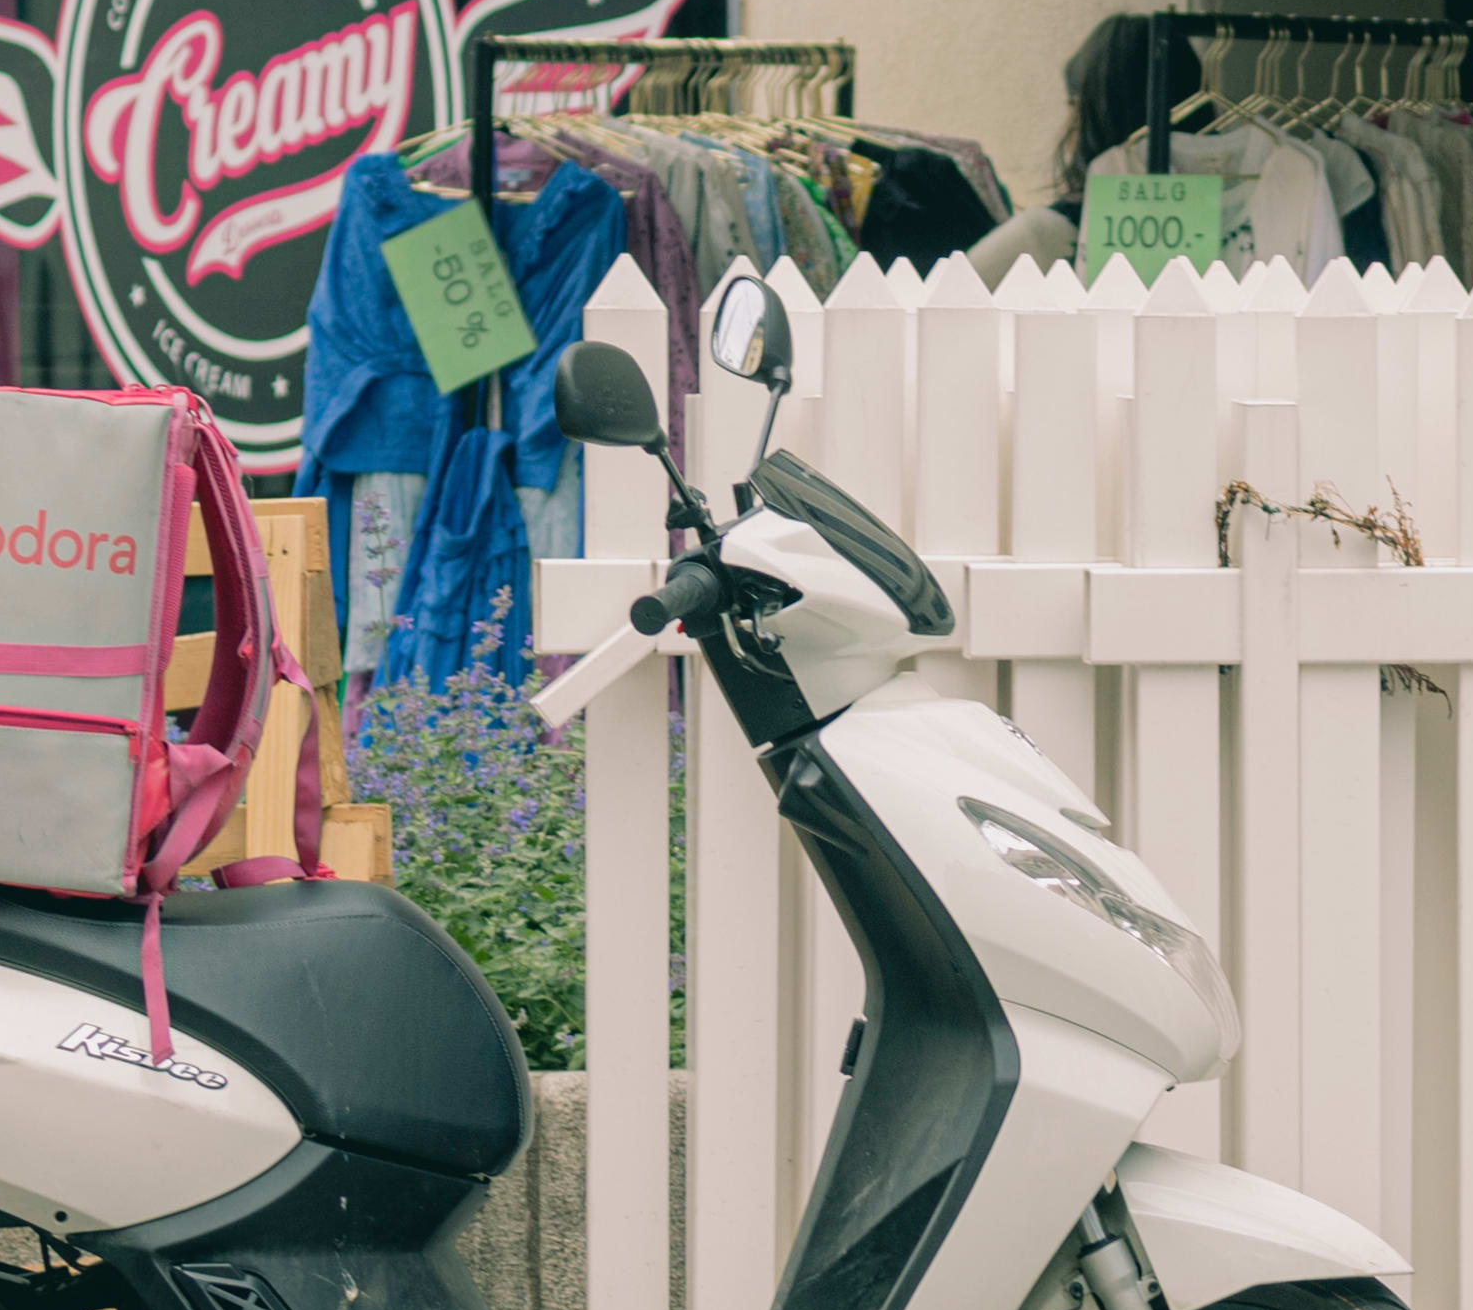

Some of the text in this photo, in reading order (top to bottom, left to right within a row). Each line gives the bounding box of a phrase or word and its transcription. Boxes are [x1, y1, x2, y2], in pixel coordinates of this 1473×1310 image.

[83, 0, 418, 254] Creamy
[1118, 181, 1187, 202] SALG
[1102, 215, 1205, 249] 1000.-
[151, 318, 253, 401] ICE CREAM
[56, 1022, 228, 1090] Kisee
